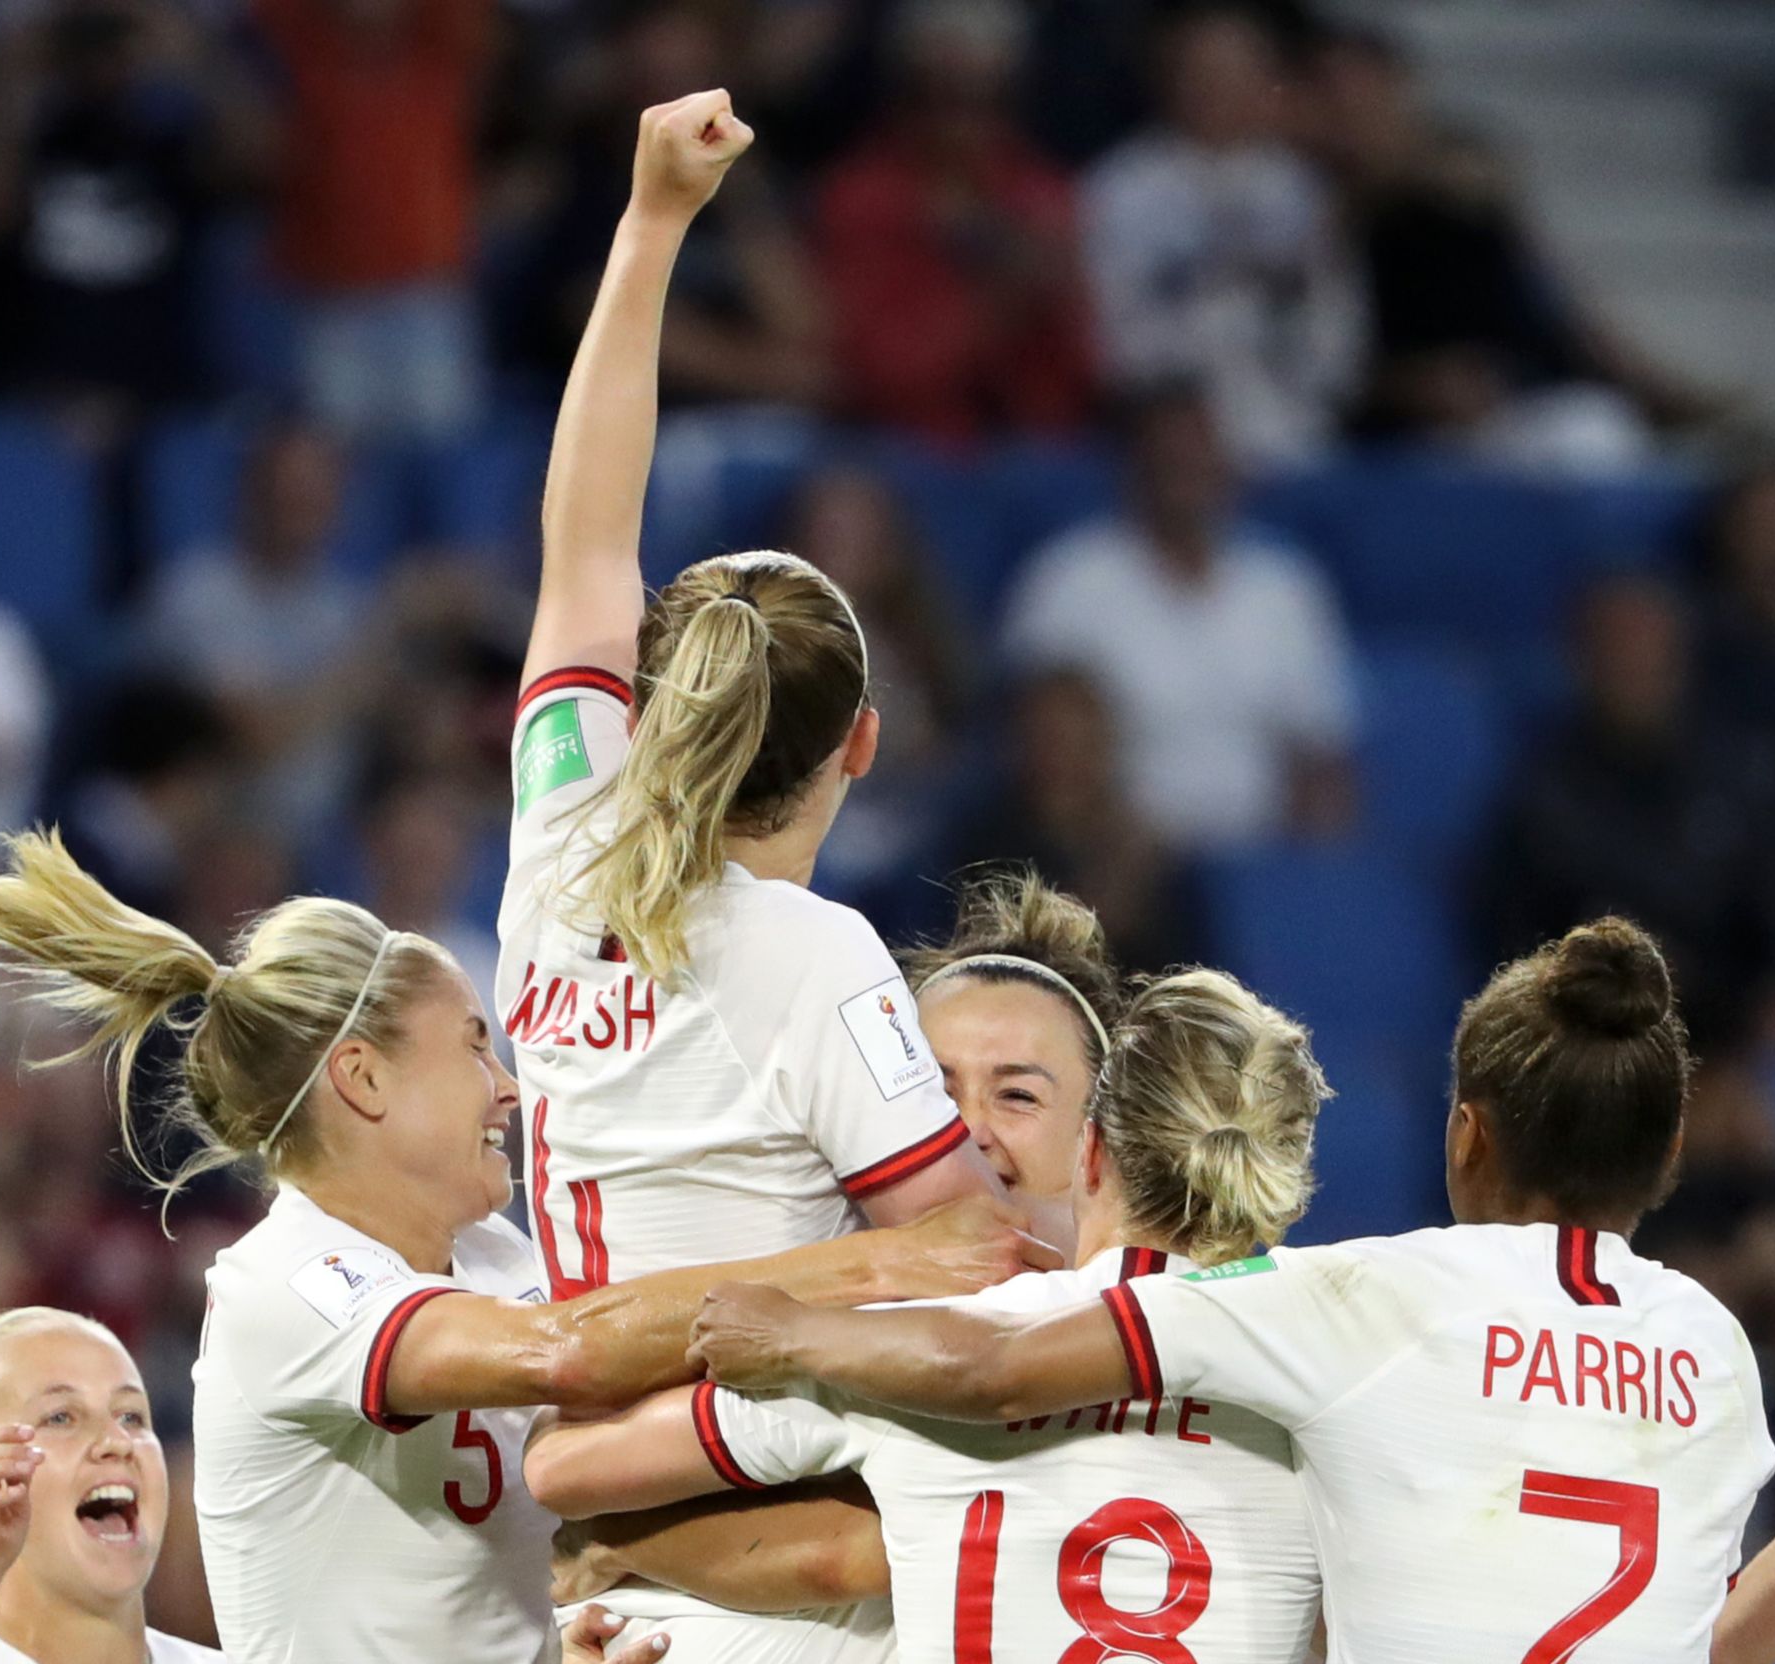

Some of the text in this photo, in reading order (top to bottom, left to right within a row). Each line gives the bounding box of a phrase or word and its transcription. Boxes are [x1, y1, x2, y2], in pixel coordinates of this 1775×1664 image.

[505, 960, 656, 1053] WASH
[1483, 1325, 1700, 1428] PARRIS
[443, 1410, 504, 1525] 5
